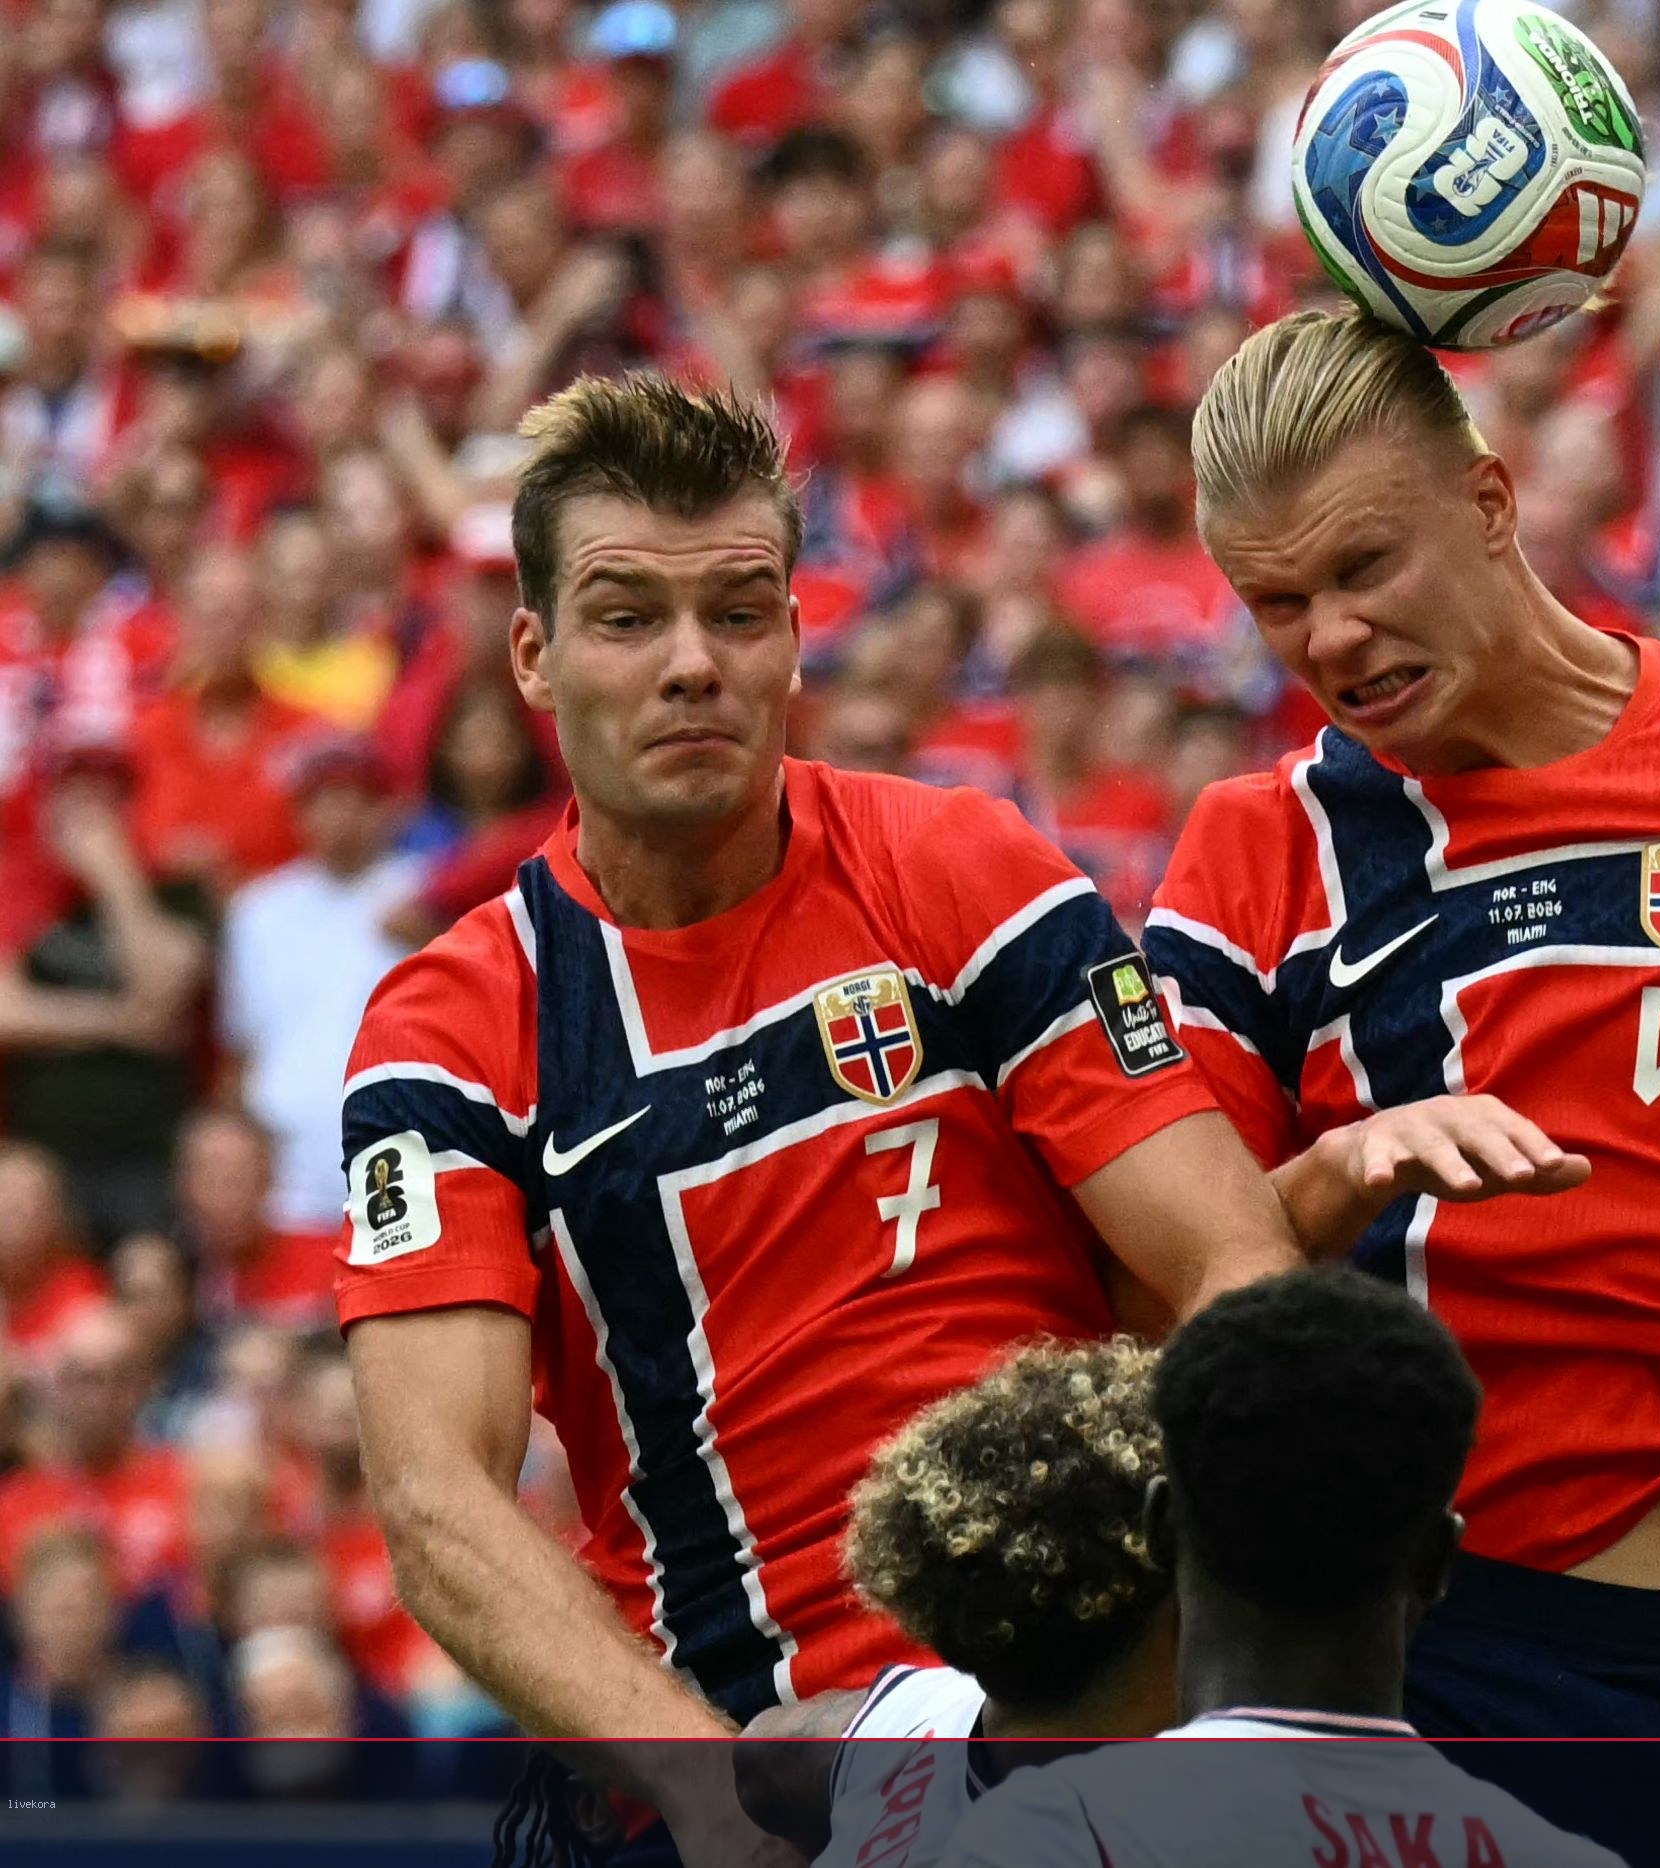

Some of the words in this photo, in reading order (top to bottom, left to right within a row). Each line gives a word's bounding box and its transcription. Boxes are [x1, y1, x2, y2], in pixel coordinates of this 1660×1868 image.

[1529, 30, 1593, 125] TRIONDA
[1492, 128, 1516, 153] FIFA
[1493, 886, 1517, 903] NOR
[1532, 878, 1557, 895] ENG
[1507, 924, 1547, 945] MIAMI
[842, 979, 872, 997] NORGE
[1148, 1042, 1169, 1058] FIFA
[723, 1104, 759, 1136] MIAMI
[864, 1117, 942, 1279] 7
[377, 1208, 397, 1224] FIFA
[373, 1227, 395, 1243] WORLD
[395, 1222, 411, 1233] CUP
[373, 1231, 412, 1255] 2026
[1302, 1793, 1507, 1868] SAKA
